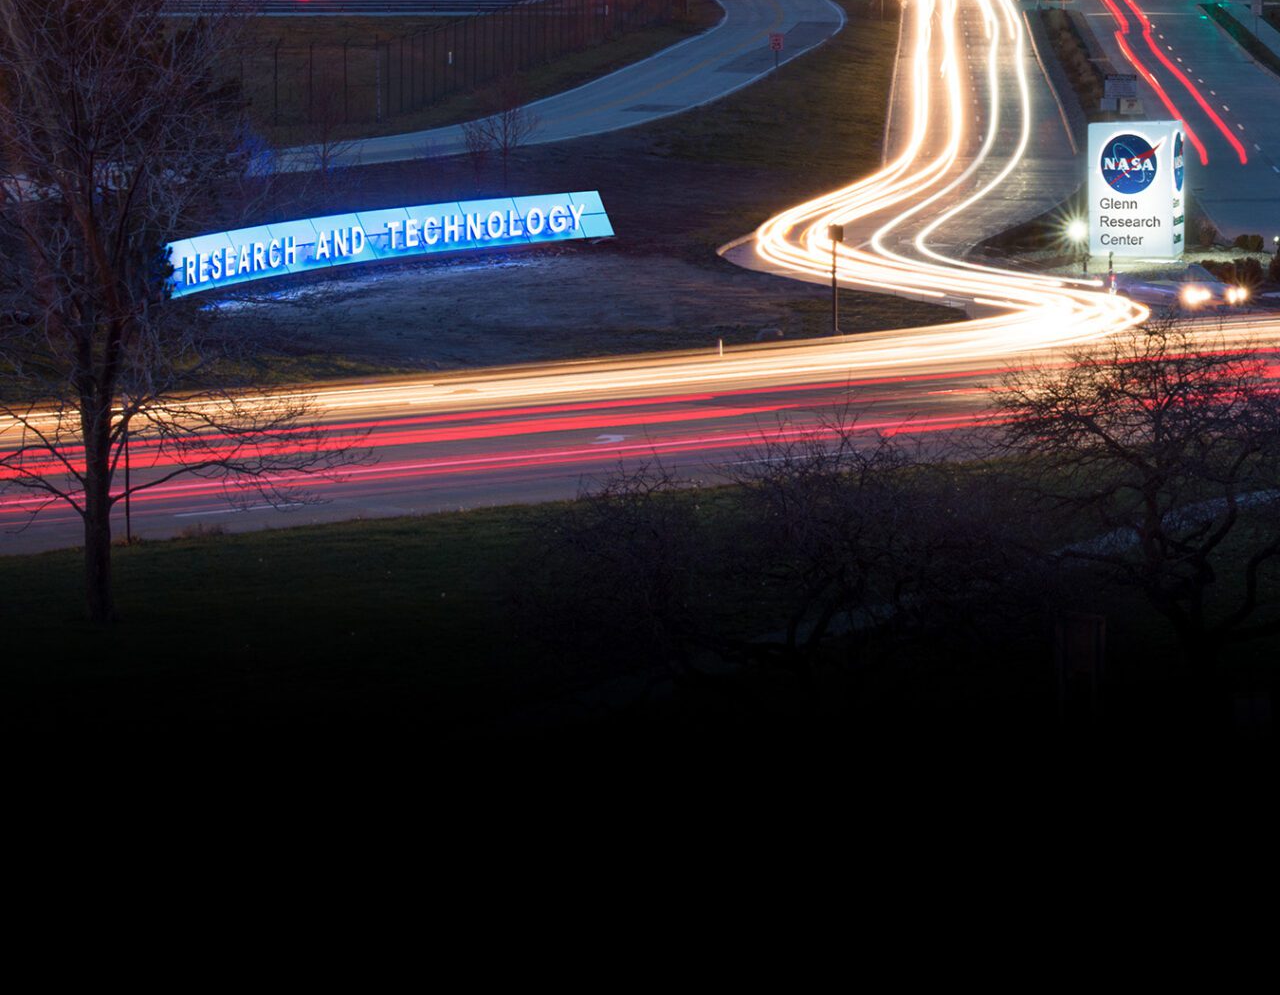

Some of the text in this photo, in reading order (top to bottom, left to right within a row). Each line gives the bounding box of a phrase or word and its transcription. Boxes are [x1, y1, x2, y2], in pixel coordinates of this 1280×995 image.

[1104, 157, 1155, 172] NASA
[1099, 197, 1138, 210] Glenn
[1099, 216, 1161, 228] Research
[184, 204, 586, 286] RESEARCH AND TECHNOLOGY
[1099, 233, 1144, 246] Center
